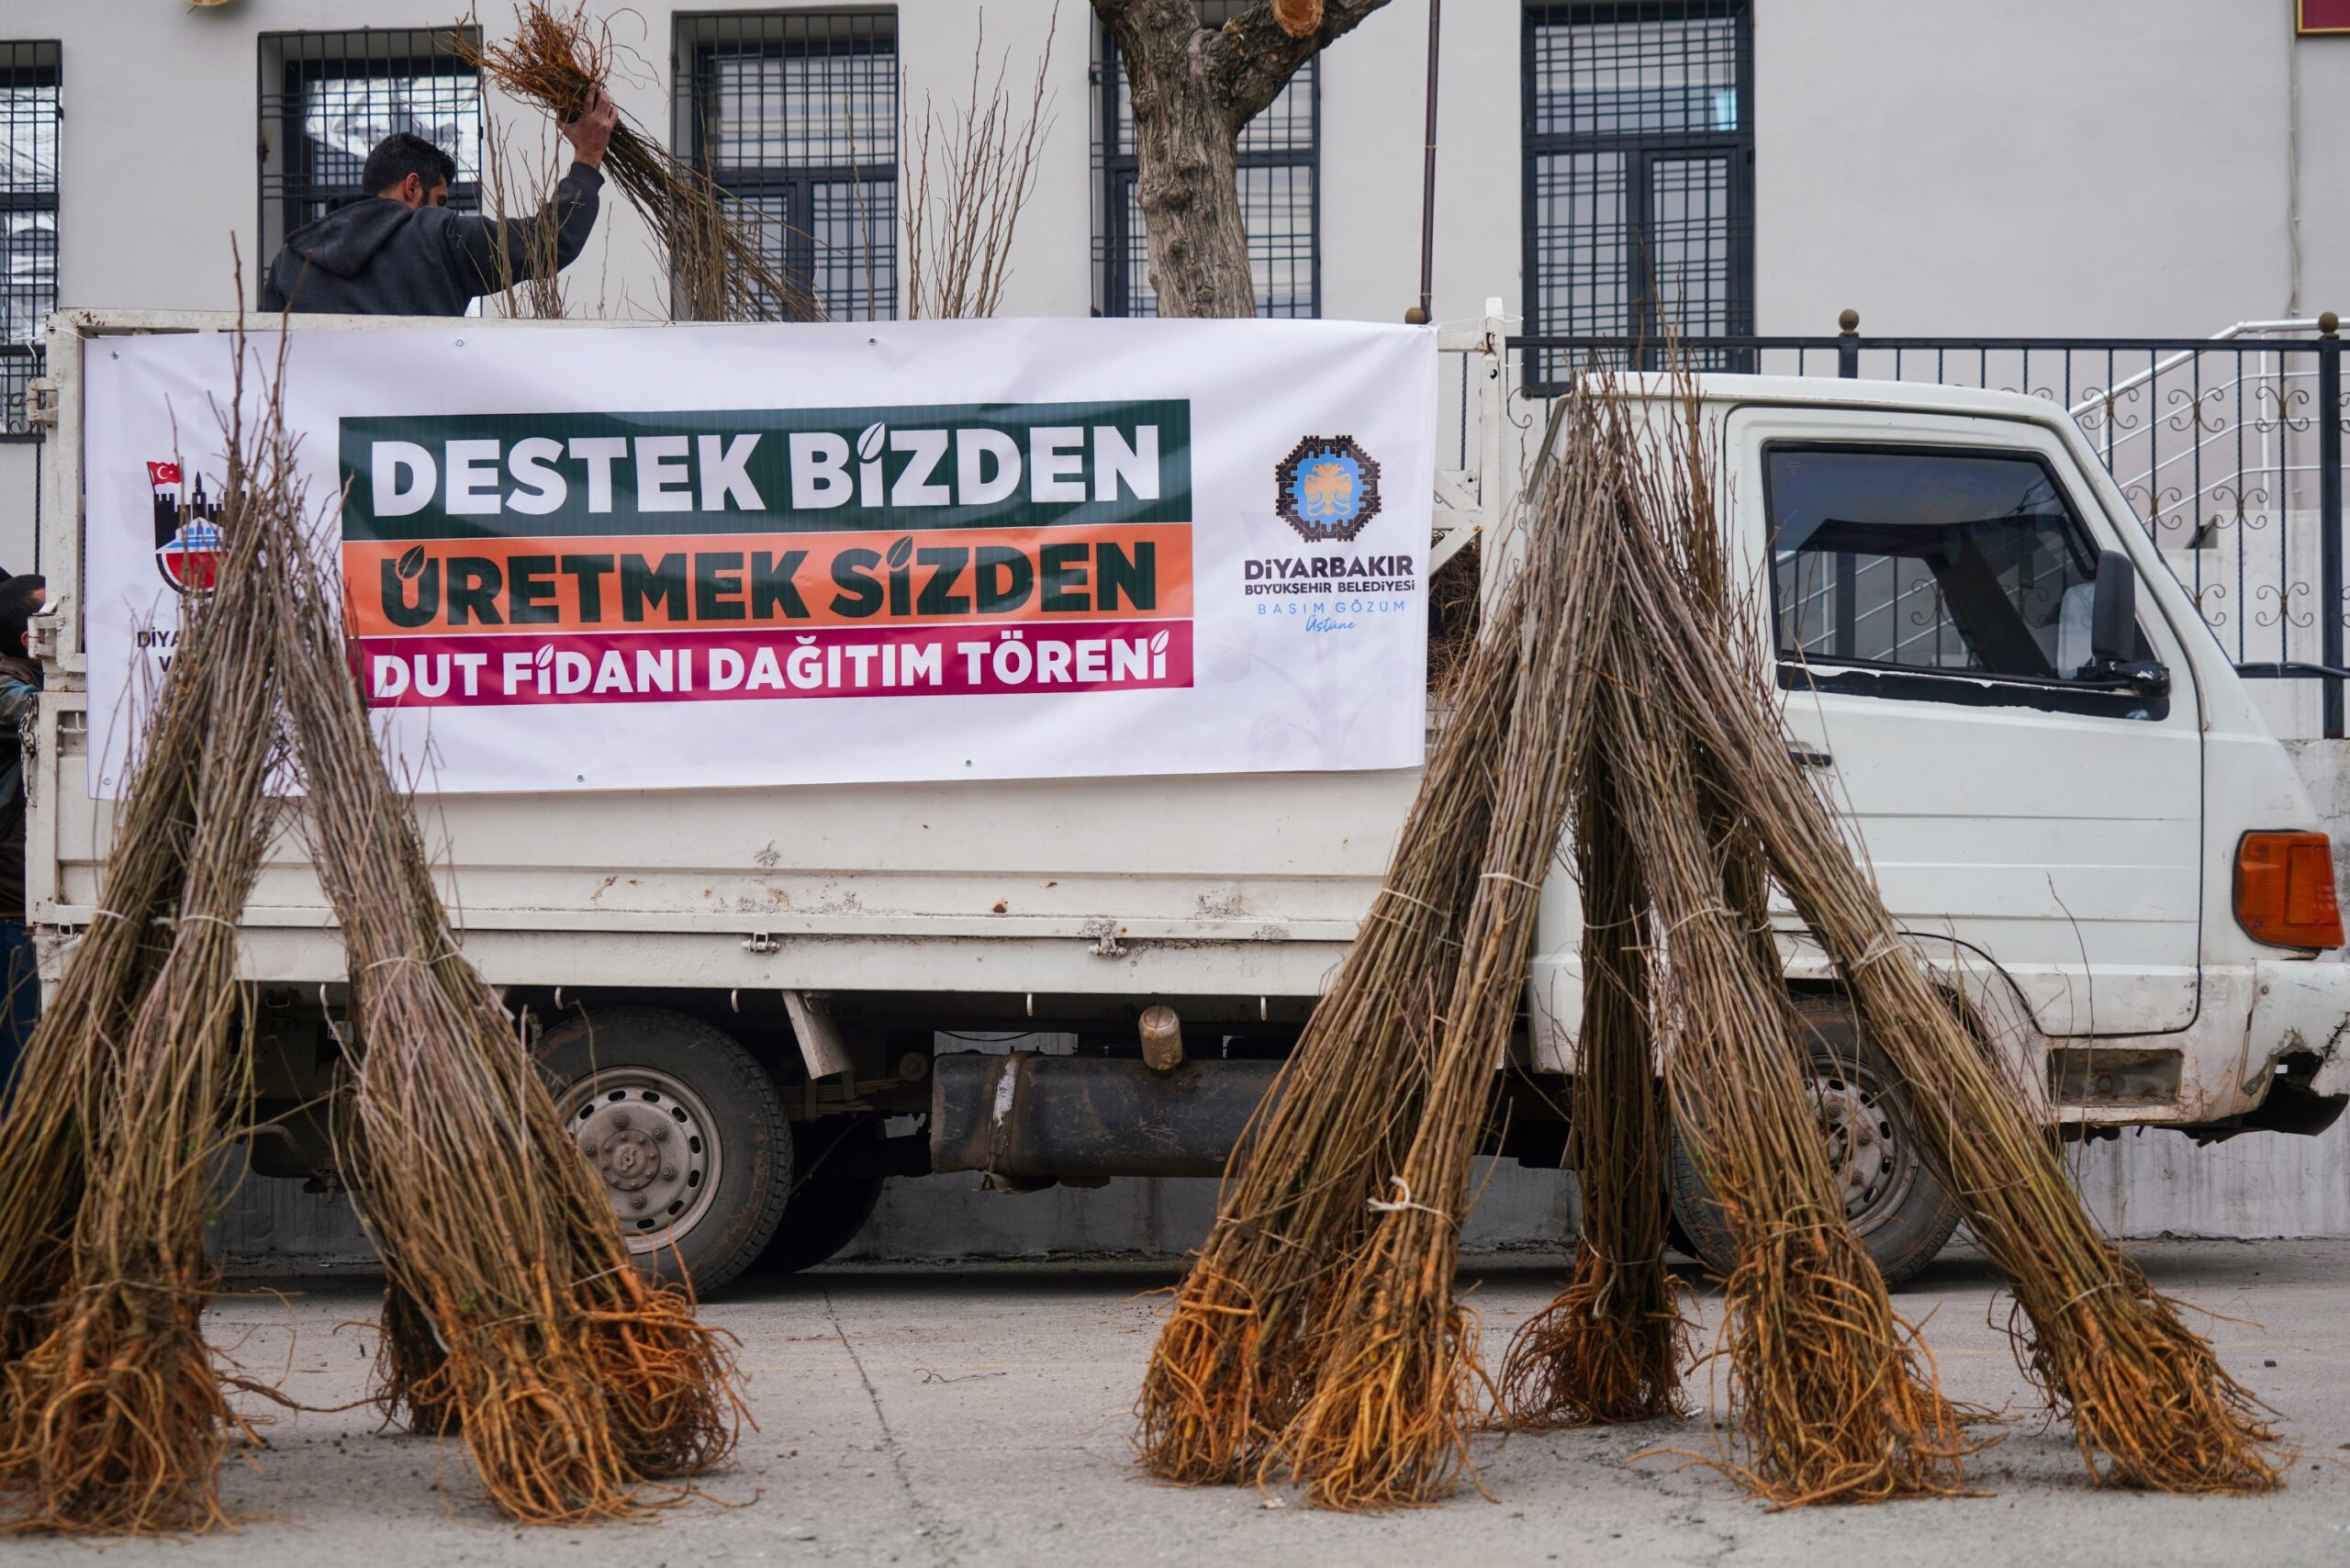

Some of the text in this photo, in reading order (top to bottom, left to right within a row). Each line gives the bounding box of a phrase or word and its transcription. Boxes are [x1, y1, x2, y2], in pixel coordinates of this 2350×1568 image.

[372, 433, 767, 517] DESTEK
[1335, 599, 1405, 613] GÖZÜM
[373, 653, 488, 698] DUT
[709, 635, 943, 691] DAĞITIM
